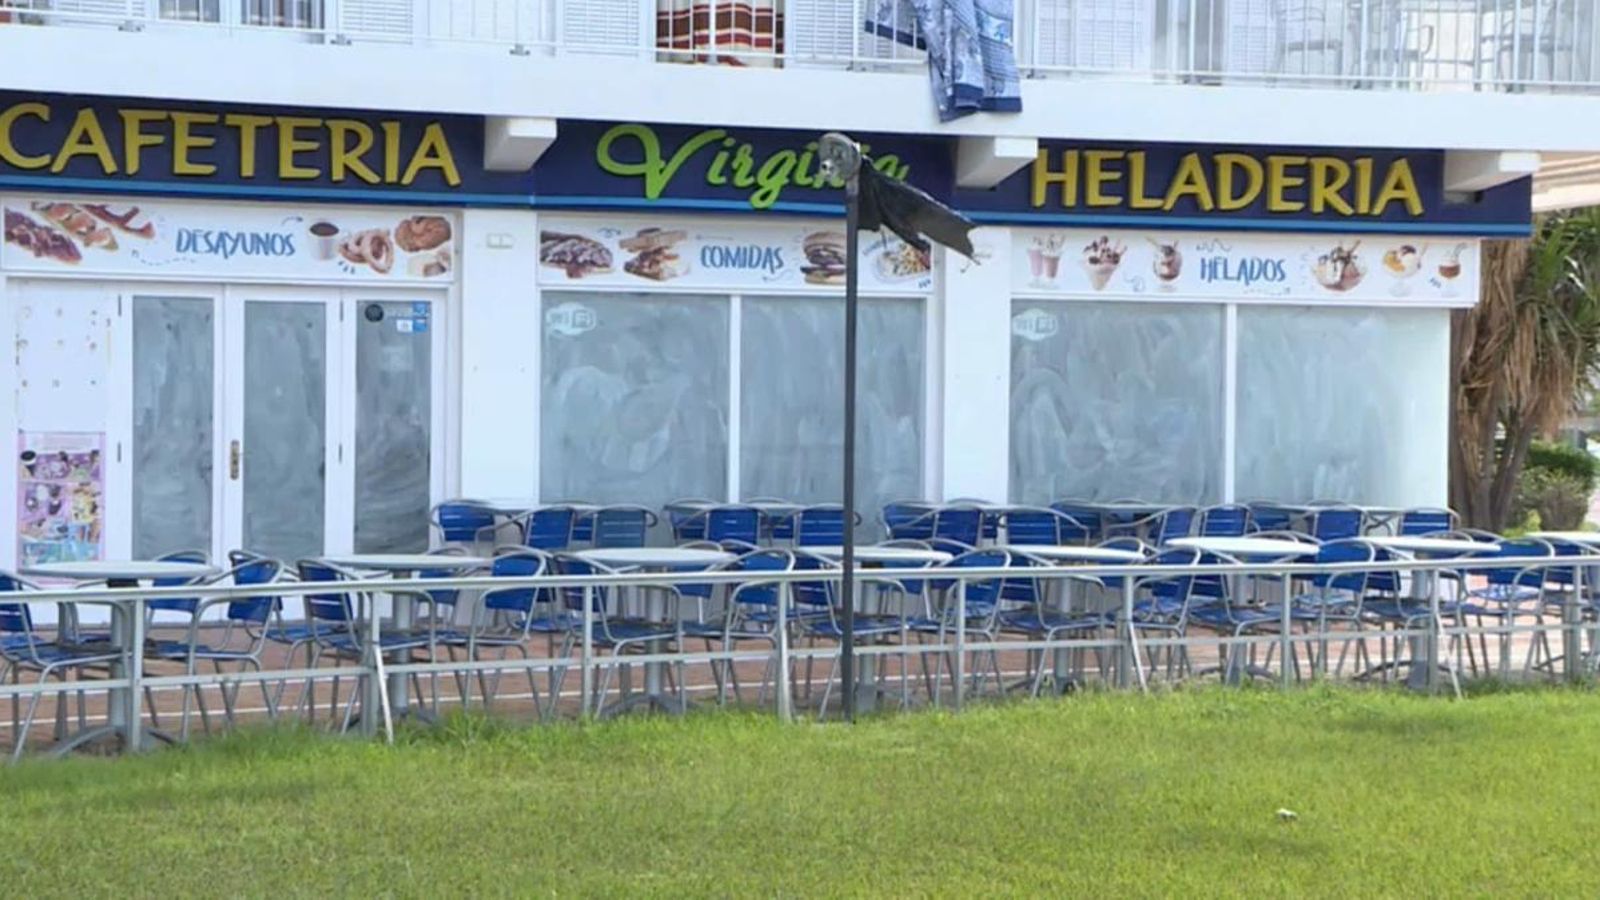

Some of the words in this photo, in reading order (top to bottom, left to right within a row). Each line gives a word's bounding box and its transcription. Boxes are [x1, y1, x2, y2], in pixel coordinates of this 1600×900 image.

[0, 102, 462, 187] CAFETERIA
[1031, 148, 1423, 216] HELADERIA
[175, 227, 297, 259] DESAYUNOS
[700, 245, 784, 274] COMIDAS
[1199, 255, 1287, 285] HELADOS
